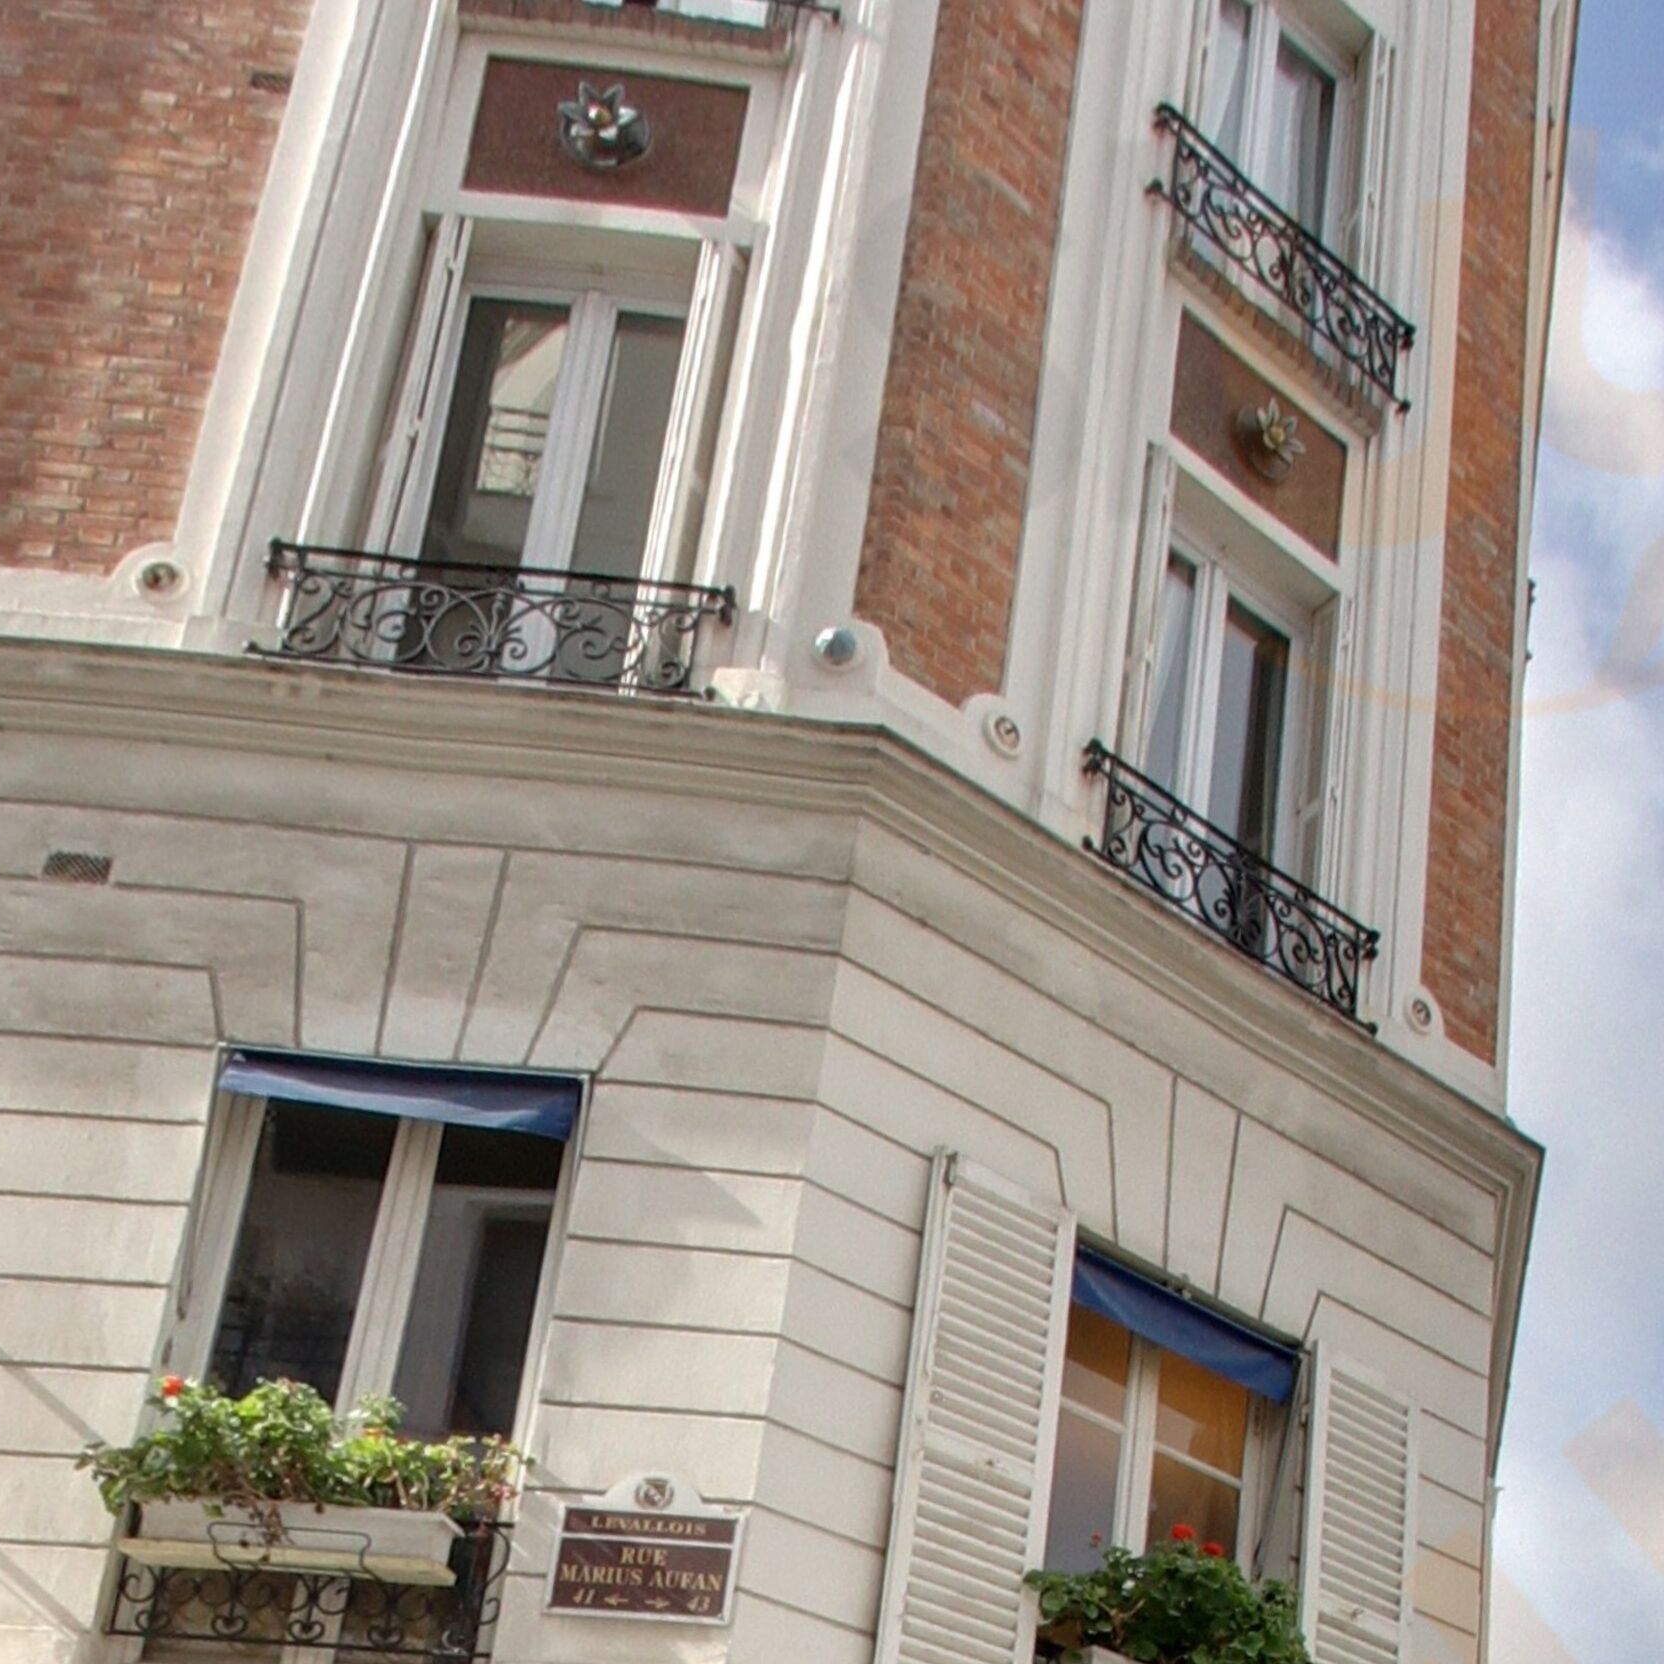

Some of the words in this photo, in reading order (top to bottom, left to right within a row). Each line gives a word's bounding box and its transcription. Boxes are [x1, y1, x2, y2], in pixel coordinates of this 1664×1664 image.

[591, 1515, 708, 1536] LEVALLOIS
[620, 1547, 669, 1567] RUE
[559, 1564, 643, 1587] MARIUS
[648, 1571, 723, 1592] AUFAN
[572, 1589, 596, 1605] 41
[685, 1596, 712, 1613] 43
